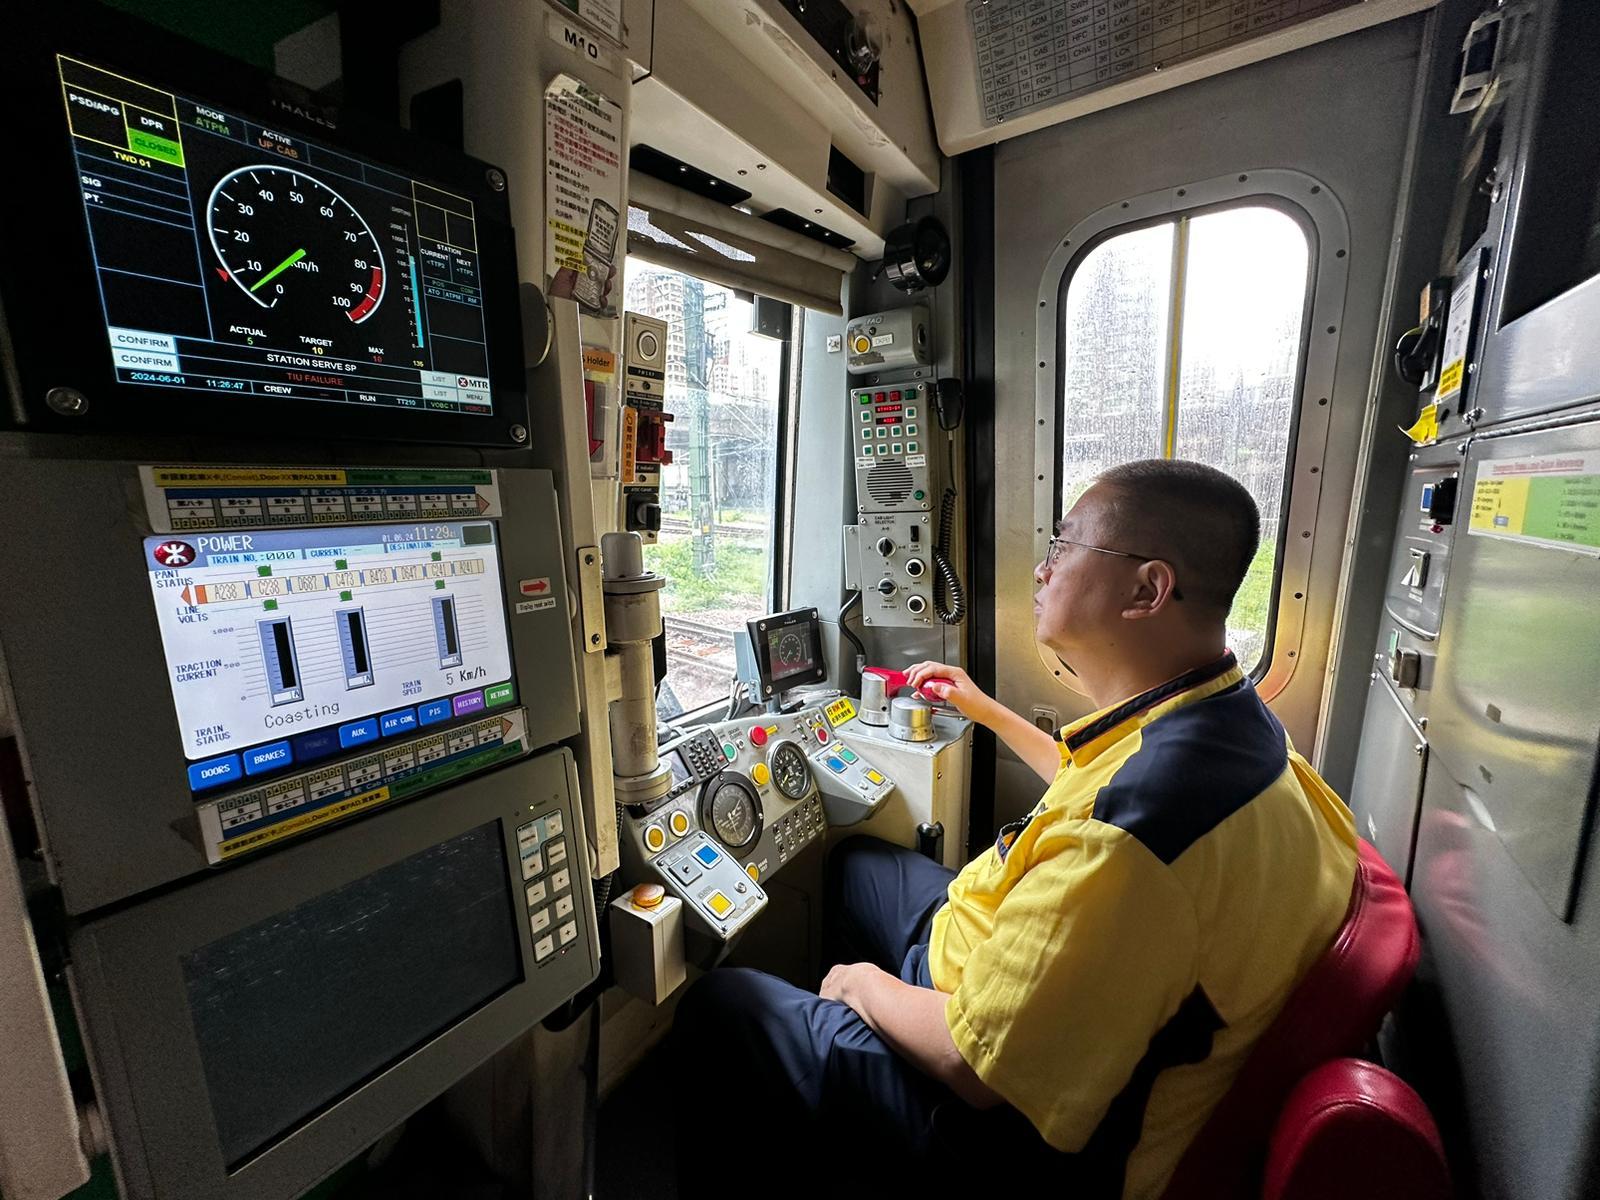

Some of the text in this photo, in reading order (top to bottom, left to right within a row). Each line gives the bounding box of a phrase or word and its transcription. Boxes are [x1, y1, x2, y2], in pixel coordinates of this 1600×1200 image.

[565, 27, 598, 59] M10
[997, 74, 1010, 86] KET
[196, 106, 225, 122] MODE
[140, 117, 164, 131] DPR
[195, 118, 229, 135] ATPM
[262, 130, 291, 145] ACTIVE
[134, 137, 177, 157] CLOSED
[258, 138, 298, 159] UP CAB
[113, 151, 151, 168] TWD 01
[82, 176, 101, 187] SIG
[259, 190, 274, 202] 40
[289, 192, 304, 204] 50
[238, 204, 253, 216] 30
[320, 206, 333, 218] 60
[234, 230, 249, 242] 20
[344, 231, 356, 242] 70
[420, 248, 449, 260] CURRENT
[437, 244, 461, 255] STATION
[247, 260, 262, 272] 10
[355, 259, 367, 269] 80
[456, 258, 472, 267] NEXT
[276, 284, 284, 294] 0
[350, 283, 363, 293] 90
[428, 288, 440, 296] ATO
[332, 296, 350, 307] 100
[230, 326, 267, 338] ACTUAL
[118, 335, 169, 348] CONFIRM
[300, 336, 333, 347] TARGET
[368, 346, 384, 354] MAX
[122, 355, 172, 367] CONFIRM
[267, 354, 357, 372] STATION SERVE SP
[587, 356, 610, 367] Holder
[131, 372, 244, 390] 2024-06-01 11:26:47
[287, 372, 344, 385] TIU FAILURE
[469, 380, 488, 389] MTR
[264, 385, 292, 394] CREW
[415, 526, 449, 540] 11:29
[197, 535, 253, 552] POWER
[213, 554, 239, 564] TRAIN
[155, 570, 179, 579] PANT
[157, 578, 193, 588] STATUS
[258, 580, 280, 595] C238
[215, 584, 238, 599] A238
[176, 607, 199, 616] LINE
[178, 614, 208, 624] VOLTS
[176, 659, 222, 673] TRACTION
[177, 670, 217, 682] CURRENT
[446, 666, 486, 685] 5 Km/h
[402, 680, 421, 689] TRAIN
[402, 687, 422, 696] SPEED
[490, 689, 510, 699] RETURN
[458, 697, 481, 708] HISTORY
[265, 703, 340, 729] Coasting
[429, 708, 441, 716] PIS
[385, 720, 397, 728] AIR
[195, 725, 224, 738] TRAIN
[352, 729, 367, 737] AUX.
[196, 732, 231, 746] STATUS
[254, 750, 285, 764] BRAKES
[201, 764, 230, 778] DOORS
